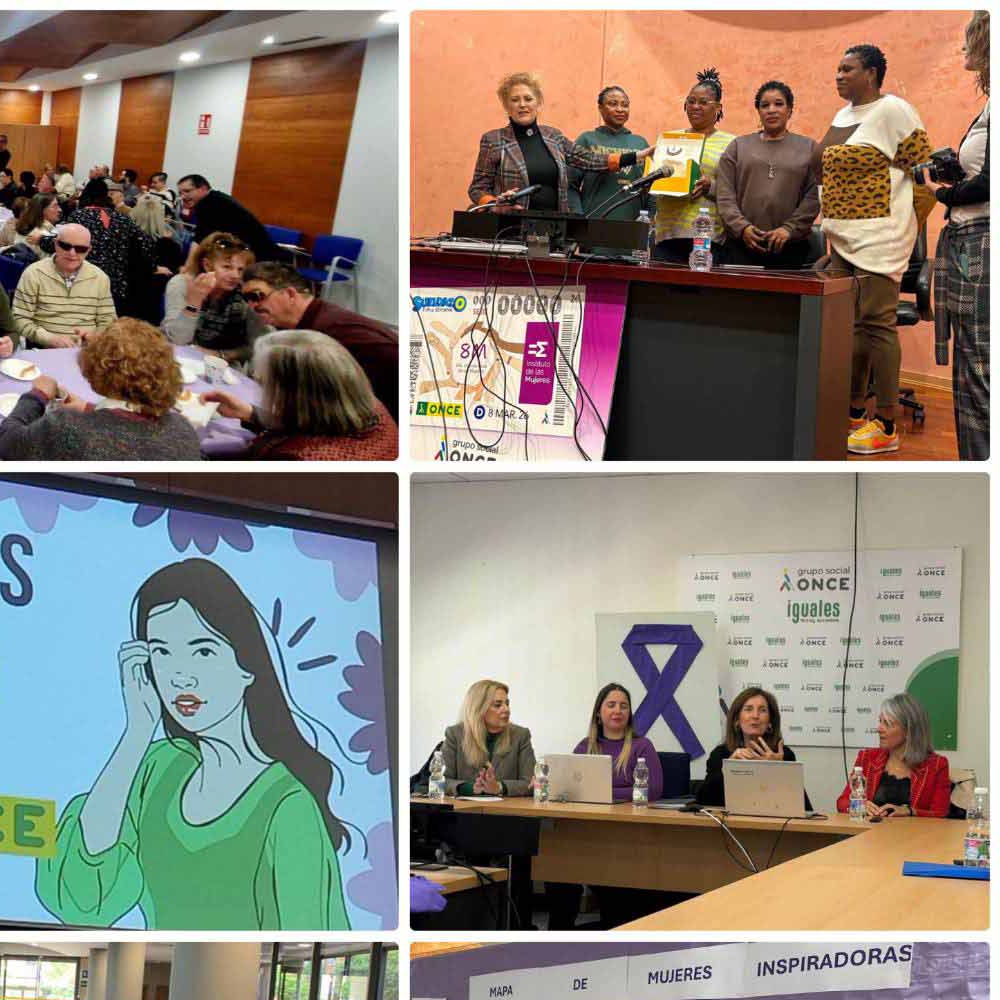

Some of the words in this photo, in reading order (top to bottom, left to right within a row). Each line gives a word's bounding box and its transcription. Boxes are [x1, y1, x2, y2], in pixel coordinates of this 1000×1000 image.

[460, 343, 487, 359] 8M
[429, 404, 461, 416] ONCE
[452, 439, 476, 450] grupo
[797, 568, 823, 576] grupo
[826, 566, 850, 574] social
[797, 577, 850, 591] ONCE
[787, 599, 840, 624] iguales
[489, 985, 513, 997] MAPA
[573, 978, 588, 990] DE
[648, 965, 712, 985] MUJERES
[756, 944, 912, 977] INSPIRADORAS
